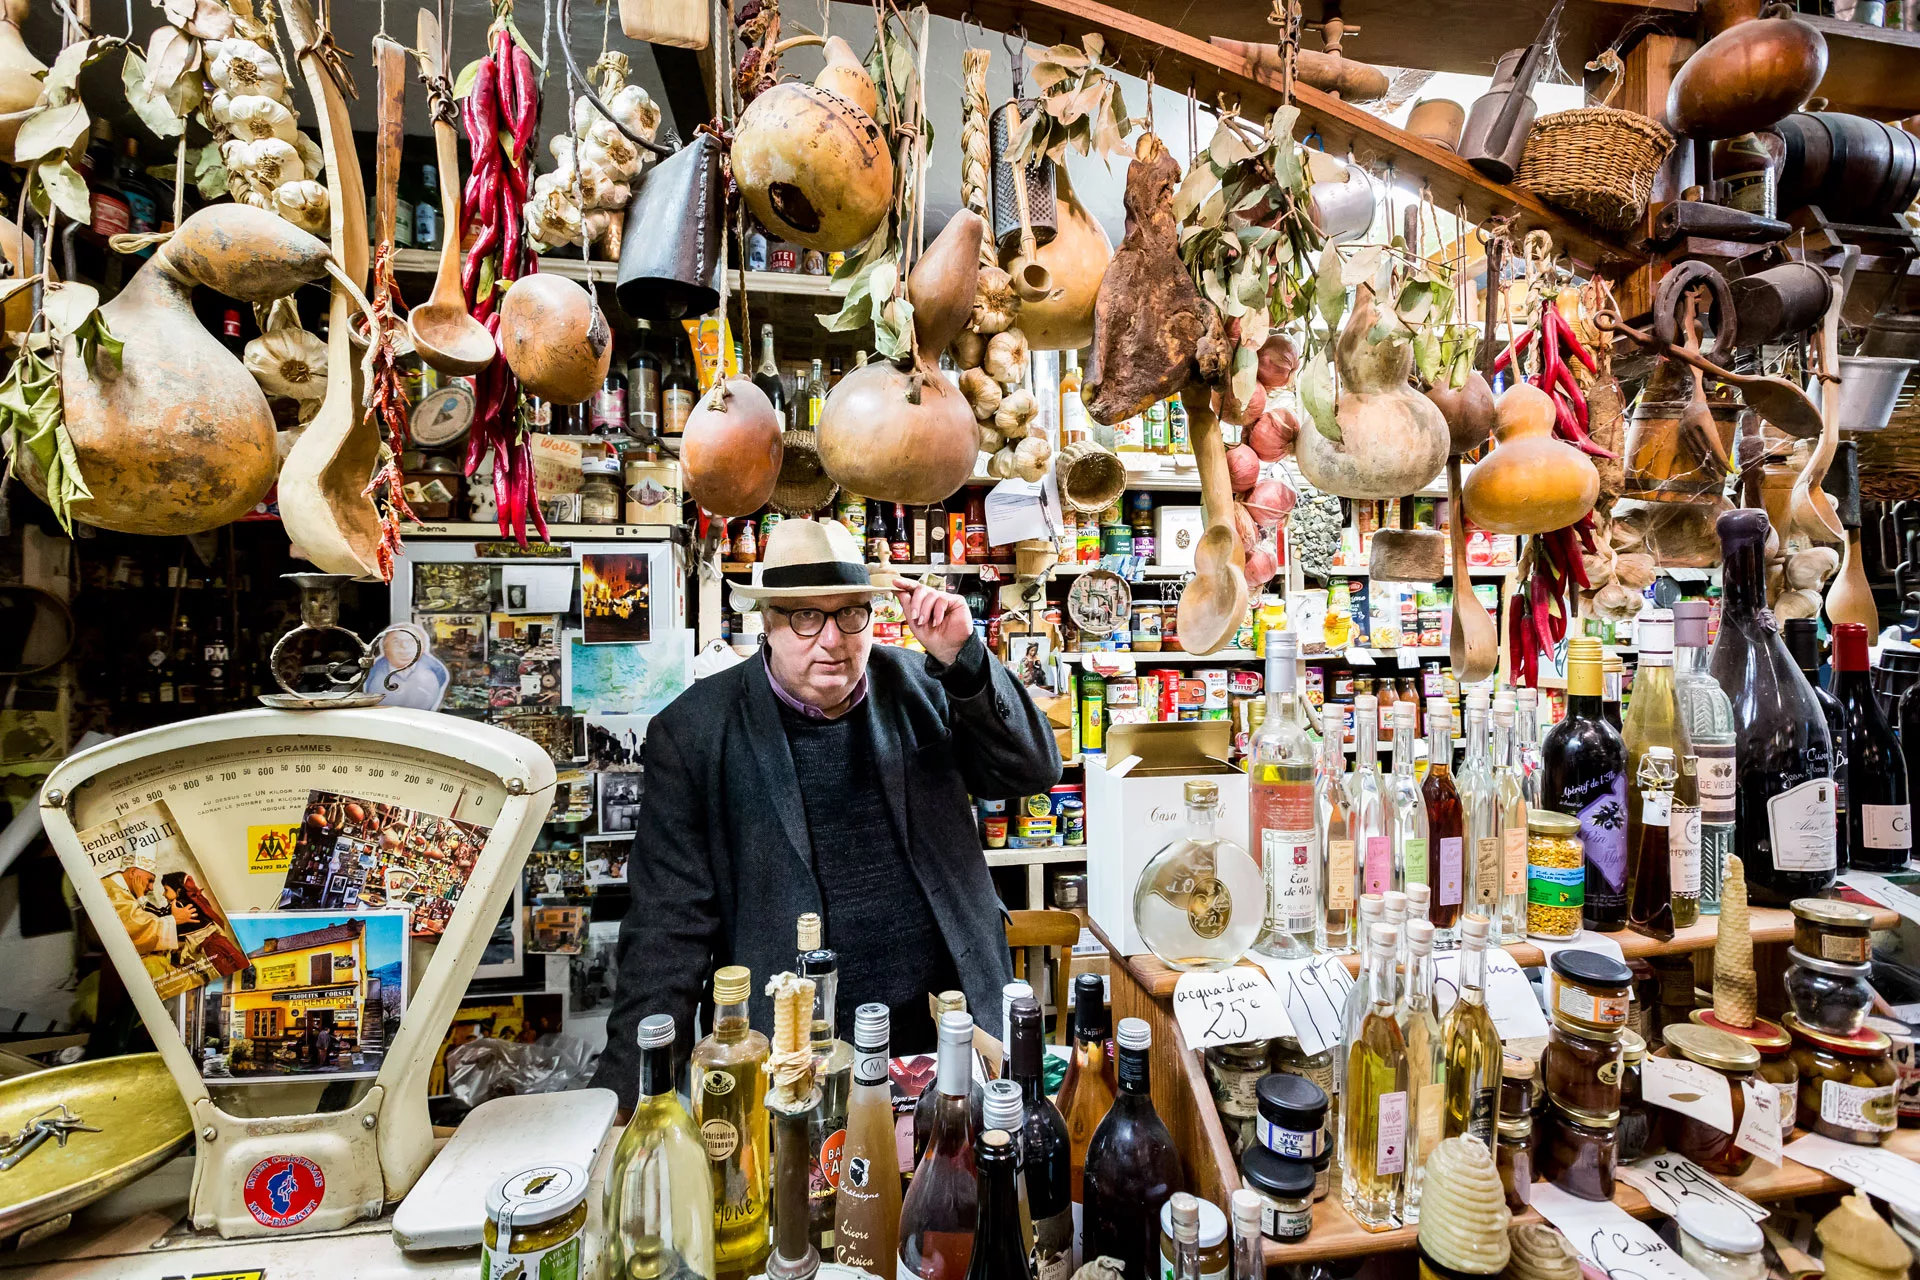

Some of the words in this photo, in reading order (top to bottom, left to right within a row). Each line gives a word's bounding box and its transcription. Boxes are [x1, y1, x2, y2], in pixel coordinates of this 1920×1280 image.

[772, 251, 793, 261] TTEI
[265, 746, 273, 754] 5
[275, 744, 332, 753] GRAMMES
[131, 796, 141, 805] 50
[146, 790, 163, 801] 900
[168, 783, 177, 792] 50
[183, 779, 200, 790] 800
[205, 774, 213, 782] 50
[220, 771, 237, 782] 700
[242, 768, 251, 776] 50
[258, 766, 274, 777] 600
[280, 764, 289, 772] 50
[295, 764, 311, 773] 500
[317, 763, 326, 771] 50
[332, 765, 348, 774] 400
[354, 765, 362, 773] 50
[368, 768, 384, 778] 300
[390, 769, 399, 777] 50
[404, 774, 420, 784] 200
[425, 777, 434, 785] 50
[439, 782, 453, 793] 100
[475, 795, 483, 806] 0
[1590, 777, 1599, 789] de
[1713, 780, 1725, 789] VIE
[215, 795, 240, 803] DESSUS
[357, 790, 389, 799] LECTURES
[197, 806, 221, 816] CADRAN
[236, 800, 262, 809] NOMBRE
[1150, 806, 1177, 822] Casa
[81, 820, 149, 853] ienheureux
[87, 845, 128, 868] Jean
[128, 828, 161, 850] Paul
[160, 822, 176, 839] II
[1290, 872, 1309, 885] Eau
[1284, 885, 1296, 897] de
[289, 991, 319, 1000] PRODUITS
[324, 989, 351, 998] CORSES
[291, 997, 352, 1007] ALIMENTATION
[1282, 1132, 1304, 1142] MYRTE
[707, 1141, 735, 1150] rtisanale
[828, 1149, 846, 1159] BA
[246, 1161, 271, 1189] INTER
[839, 1180, 880, 1203] Châtaigne
[248, 1199, 318, 1227] MINI-BASKET
[840, 1219, 869, 1240] Licore
[850, 1241, 856, 1250] di
[837, 1245, 874, 1266] Corsica
[494, 1257, 518, 1280] AESANA
